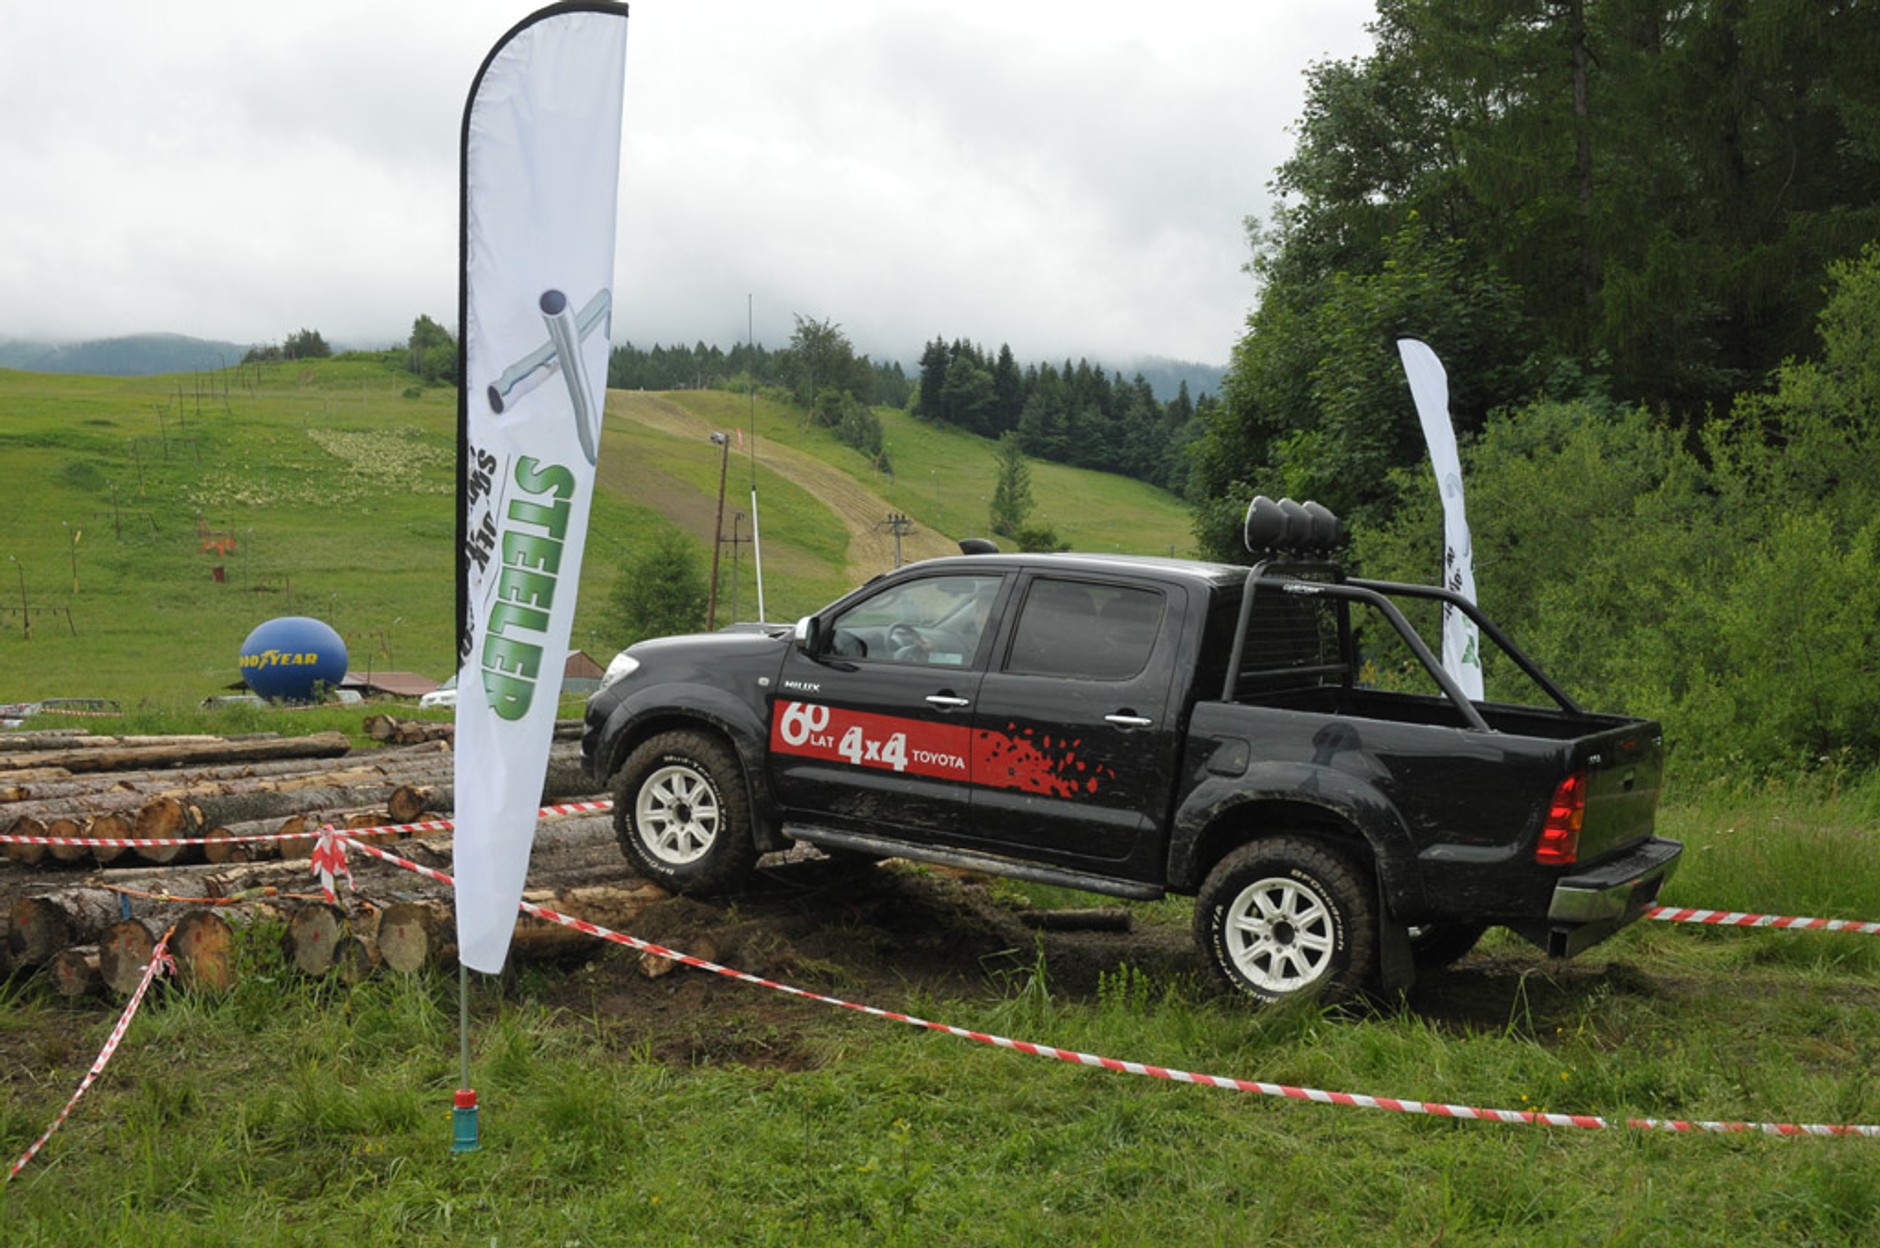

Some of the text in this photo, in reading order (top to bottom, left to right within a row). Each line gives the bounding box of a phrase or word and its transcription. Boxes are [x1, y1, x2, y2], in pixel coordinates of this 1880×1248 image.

[481, 455, 575, 720] STEELER
[784, 680, 820, 693] HILUX
[810, 733, 834, 749] LAT
[838, 725, 908, 772] 4x4
[912, 748, 965, 769] TOYOTA
